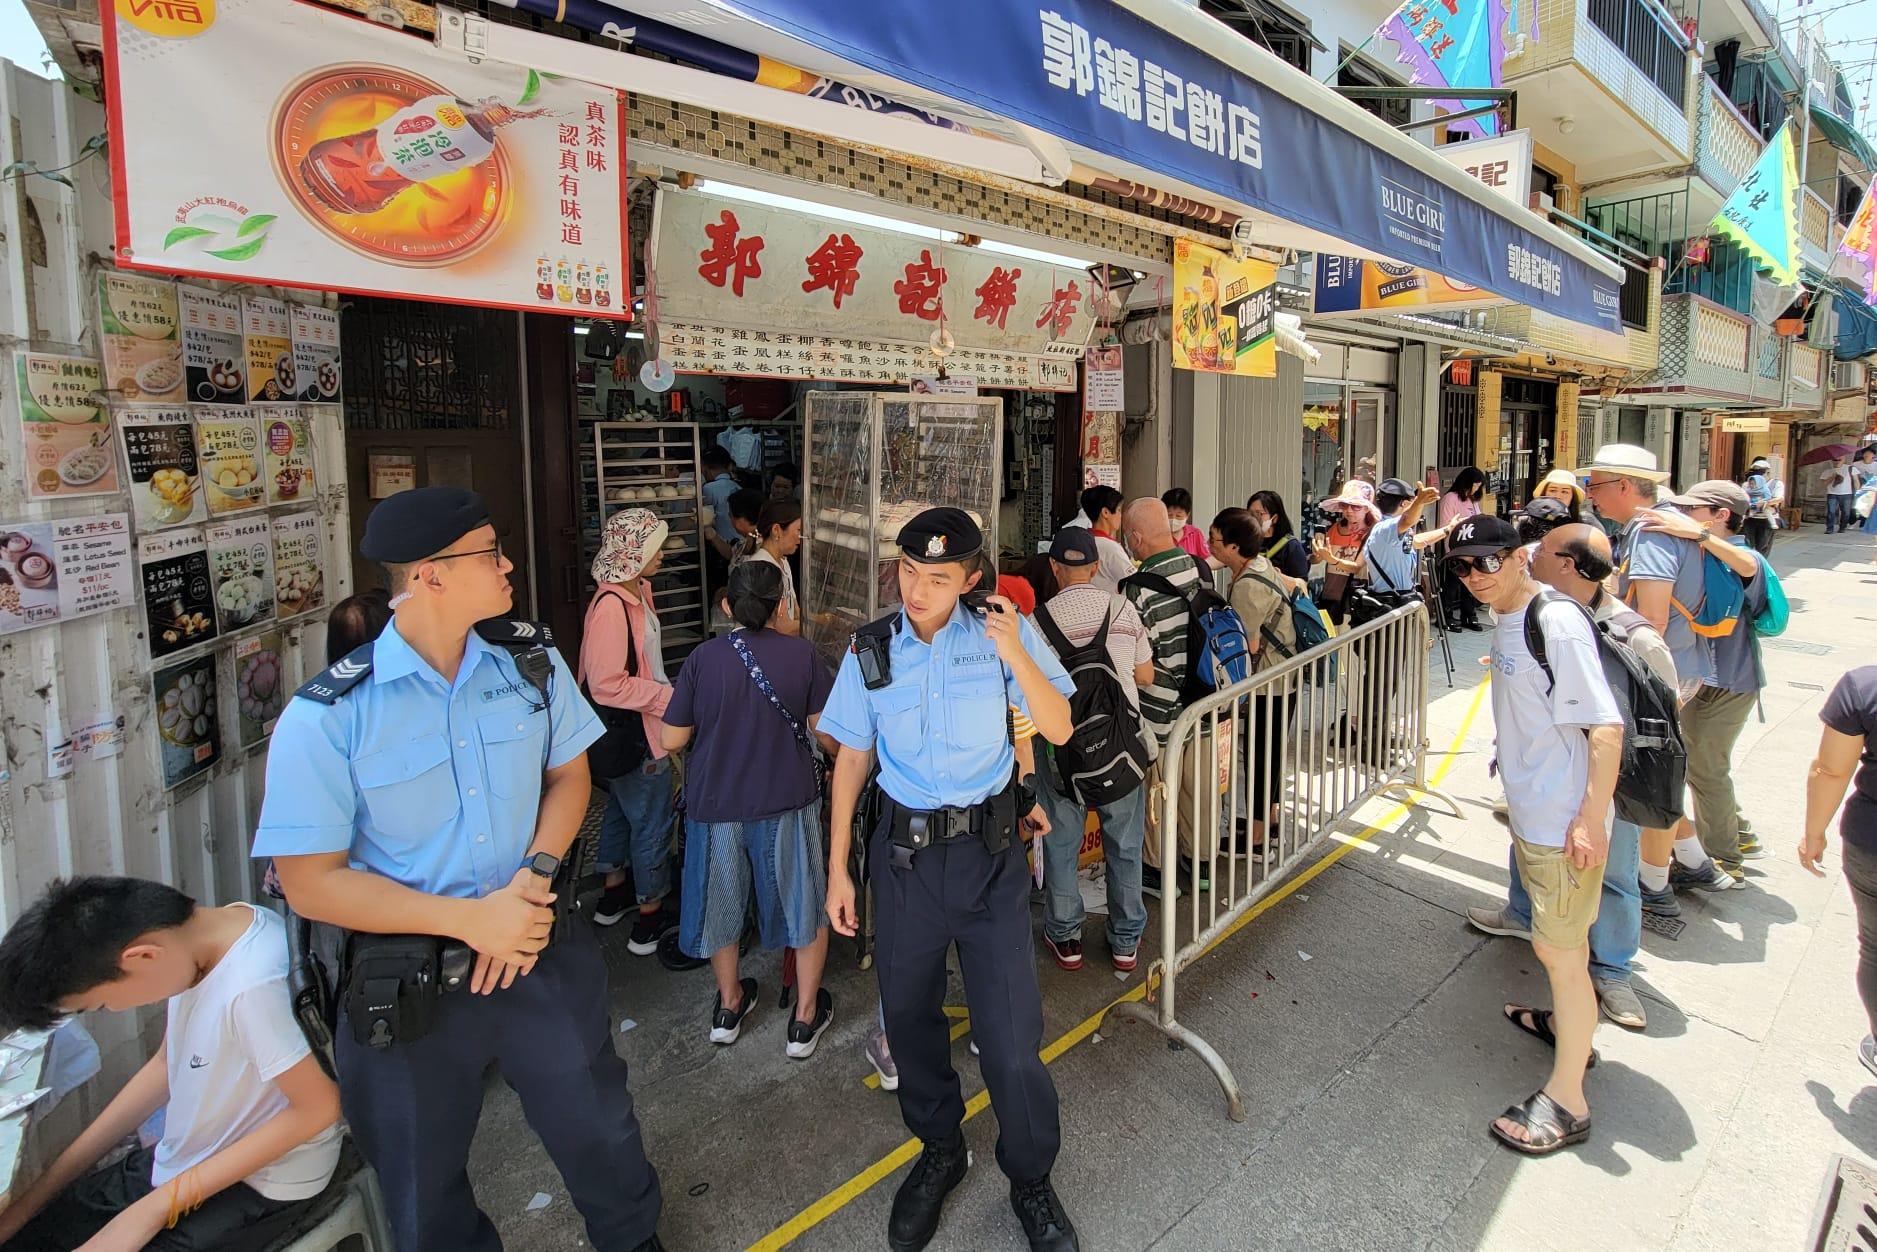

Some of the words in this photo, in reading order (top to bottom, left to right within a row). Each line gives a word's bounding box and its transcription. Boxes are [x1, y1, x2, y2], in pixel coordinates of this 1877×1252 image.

[1040, 9, 1263, 170] 郭錦記餅店
[585, 101, 607, 172] 真茶味
[558, 122, 583, 245] 認真有味道
[1741, 170, 1769, 210] 北社
[1381, 185, 1414, 220] BLUE
[1416, 203, 1445, 233] GIRL
[699, 209, 1083, 338] 郭錦記餅店
[1508, 243, 1560, 297] 郭錦記餅店
[1381, 284, 1406, 296] BLUE
[1238, 291, 1272, 328] 0糖0卡
[775, 333, 793, 375] 蛋糕仔
[58, 520, 123, 537] 馳名平安包
[83, 540, 112, 550] Sesame
[84, 552, 107, 561] Lotus
[107, 548, 127, 557] Seed
[85, 563, 100, 573] Red
[101, 561, 120, 570] Bean
[962, 654, 989, 663] POLICE
[307, 683, 333, 698] 7123
[496, 682, 528, 696] POLICE
